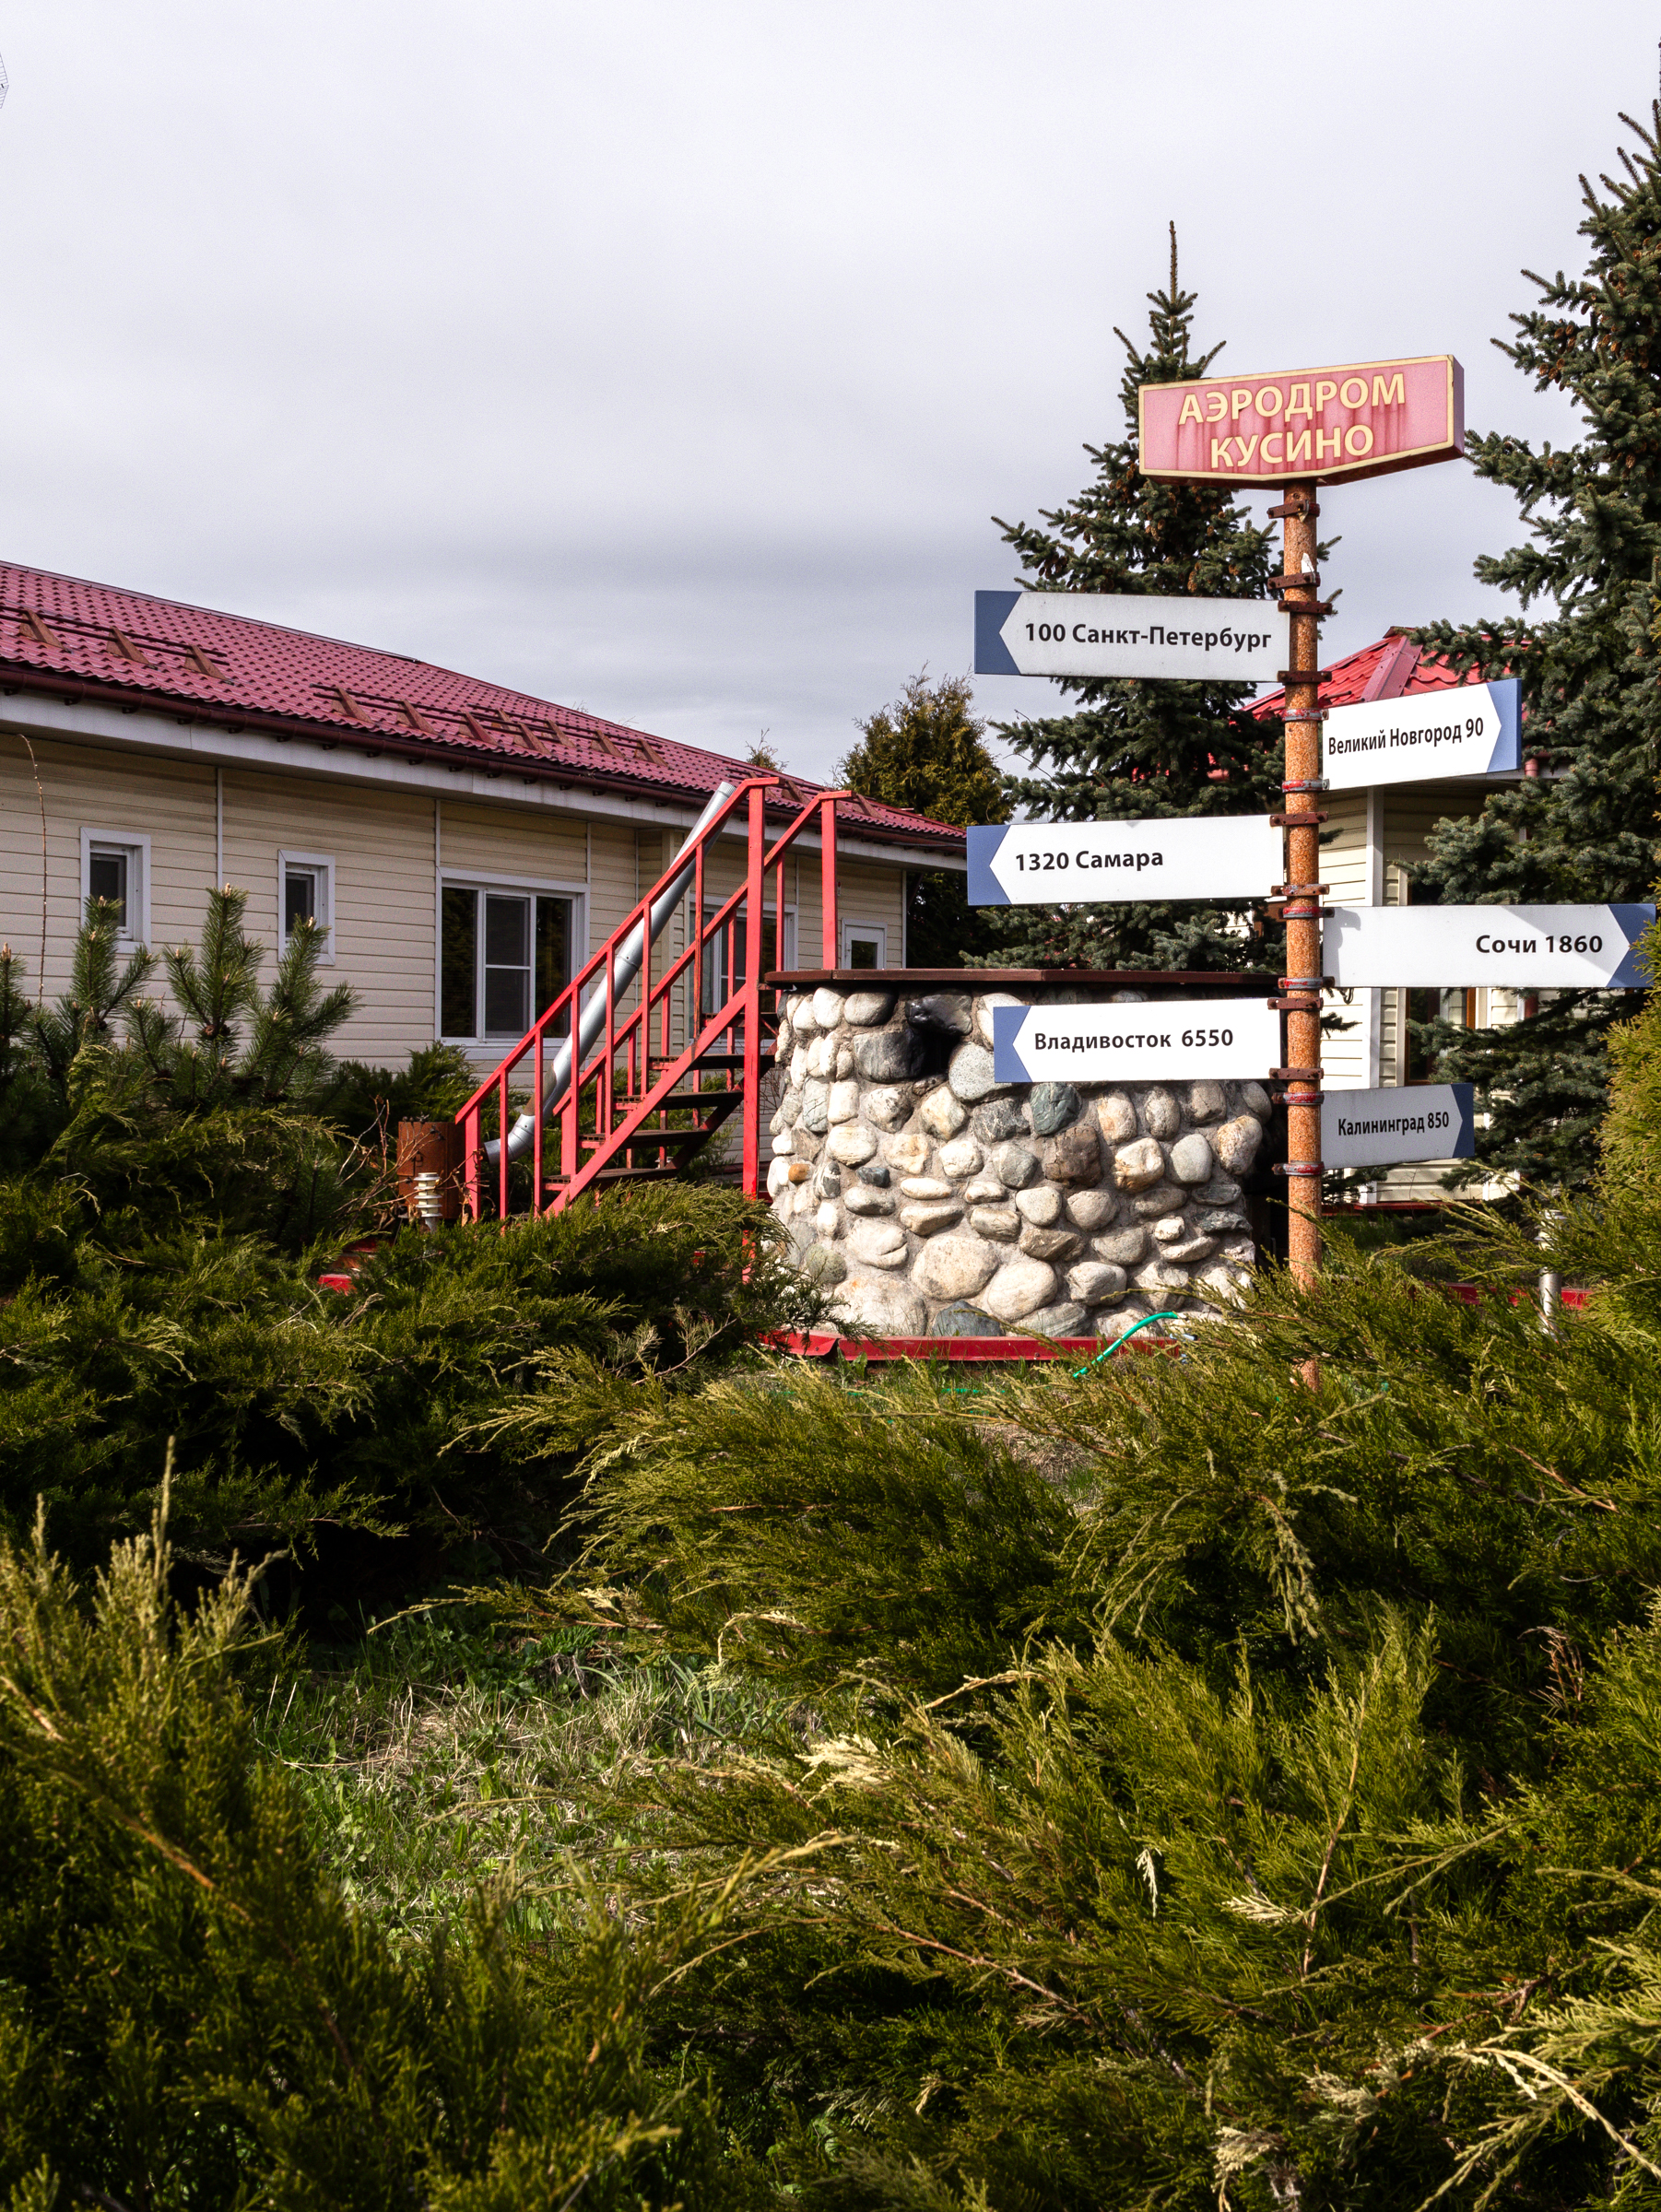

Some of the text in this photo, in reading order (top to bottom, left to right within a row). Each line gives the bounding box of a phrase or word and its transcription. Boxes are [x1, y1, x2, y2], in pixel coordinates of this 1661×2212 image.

[1178, 373, 1406, 425] АЭРОДРОМ
[1210, 424, 1374, 469] КУСИНО
[1025, 623, 1272, 653] 100 Санкт-Петербург
[1328, 717, 1484, 755] Великий Новгород 90
[1015, 850, 1164, 871] 1320 Самара
[1476, 935, 1603, 953] Сочи 1860
[1034, 1029, 1233, 1053] Владивосток 6550
[1338, 1112, 1449, 1135] Калининград 850
